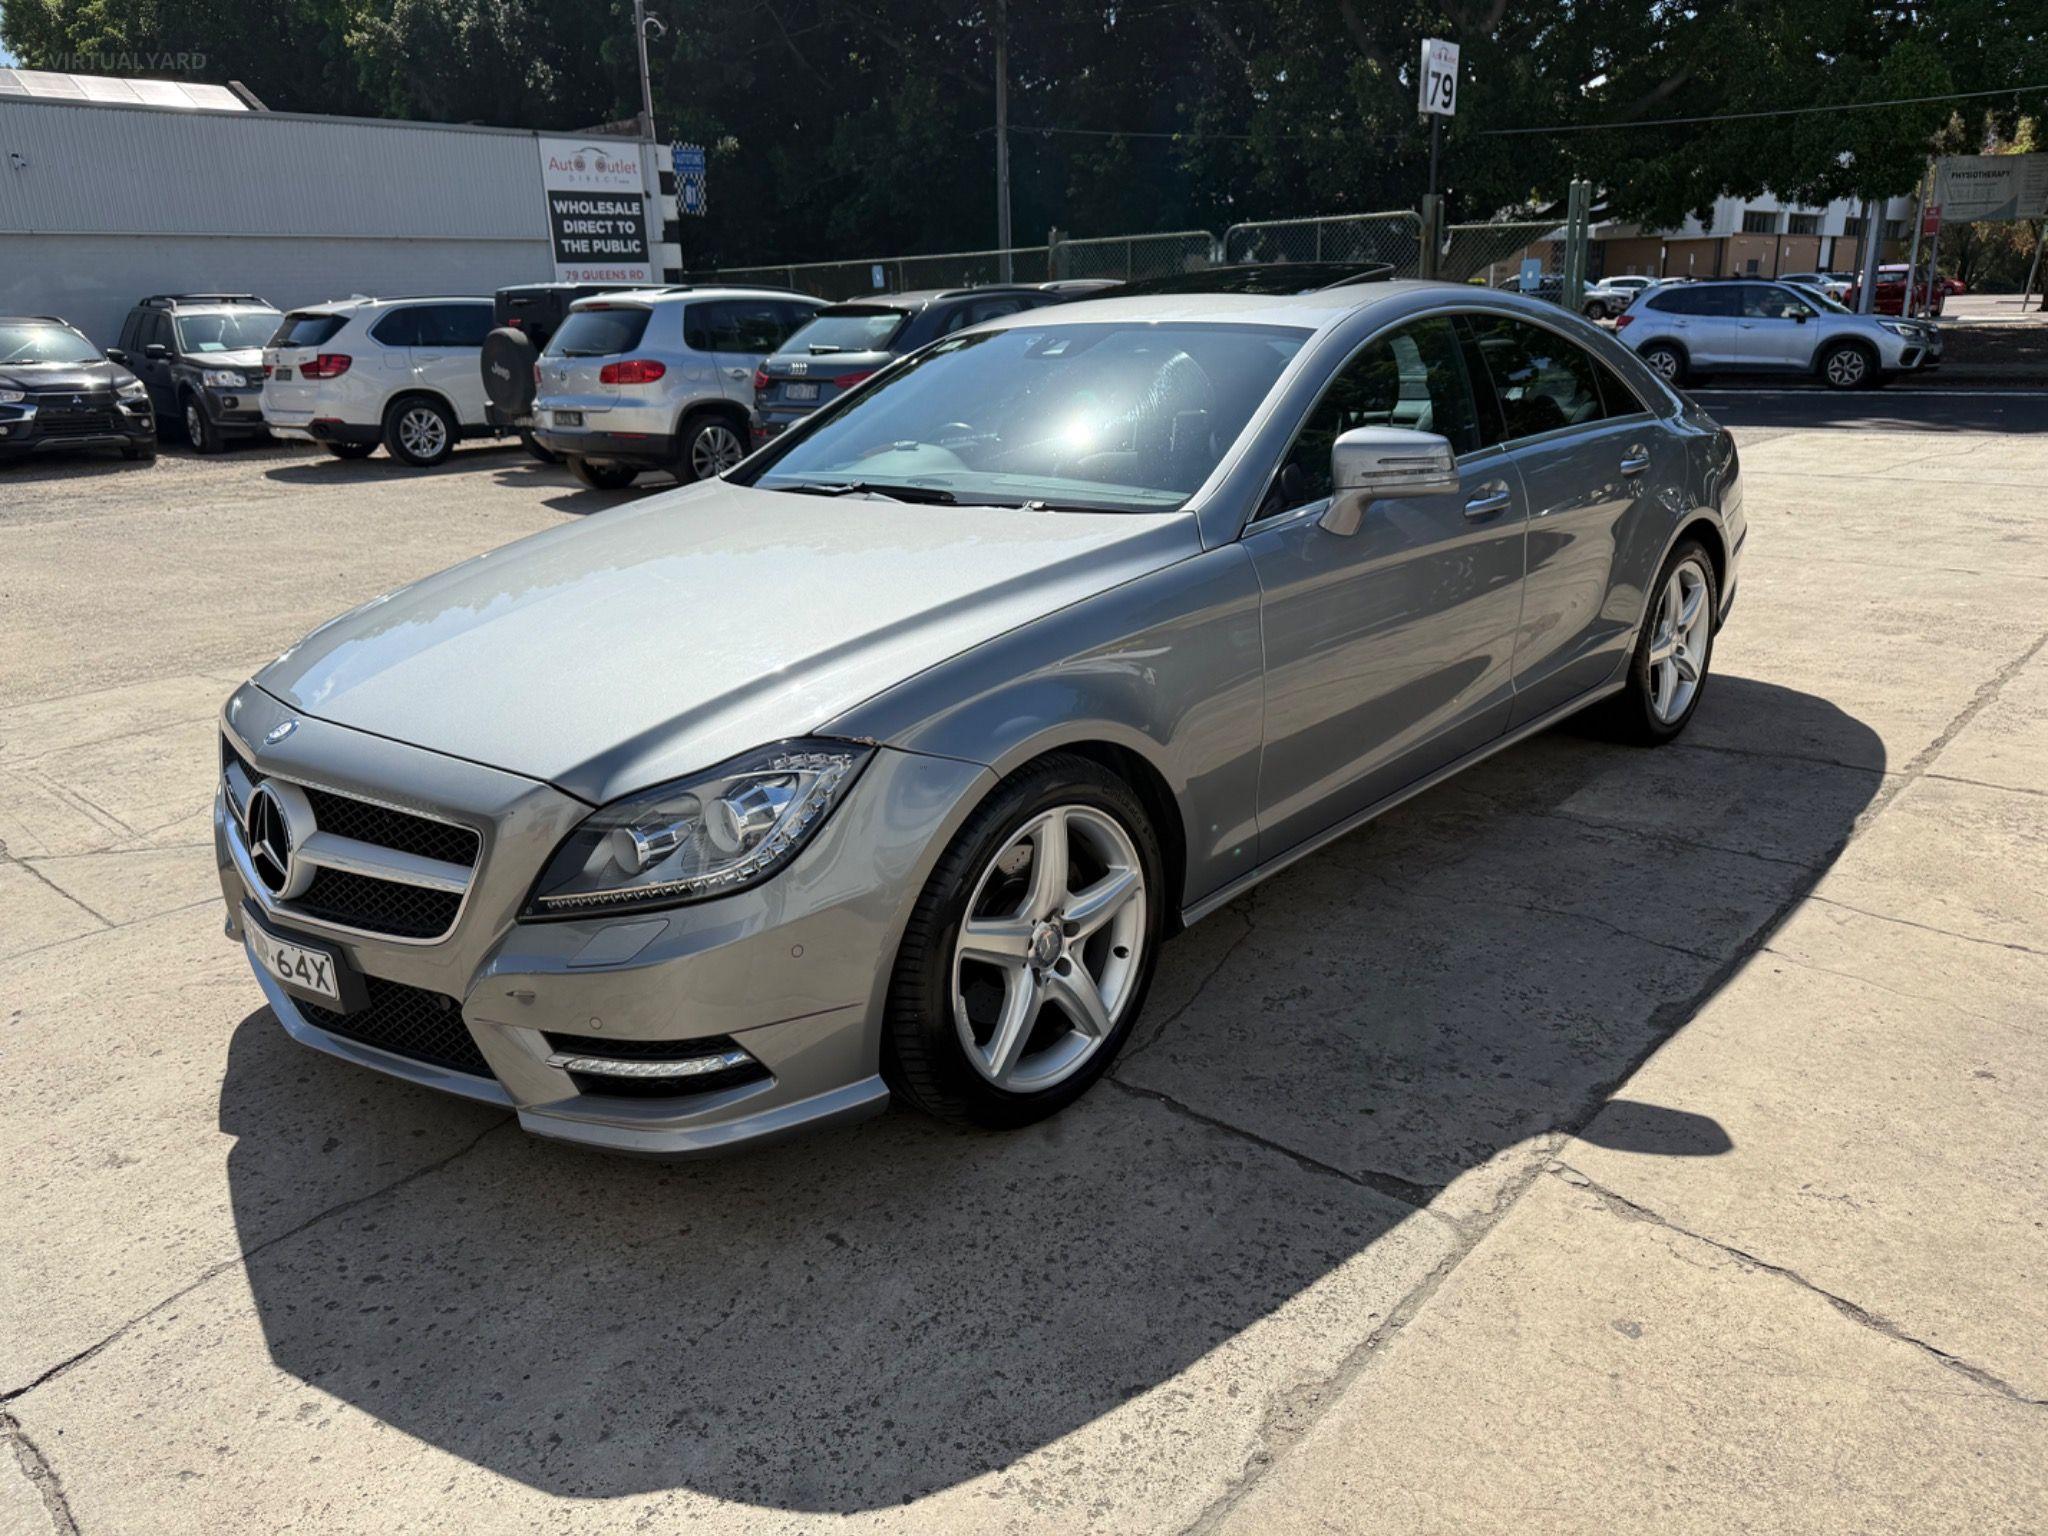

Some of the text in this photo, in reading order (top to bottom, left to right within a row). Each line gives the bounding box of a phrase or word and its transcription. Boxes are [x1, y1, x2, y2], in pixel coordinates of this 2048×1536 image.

[1430, 70, 1454, 109] 79
[1951, 170, 2011, 179] PHYSIOTHERAPY
[553, 200, 641, 215] WHOLESALE
[563, 220, 636, 234] DIRECT TO
[561, 239, 642, 253] THE PUBLIC
[565, 270, 644, 280] 79 QUEENS RD
